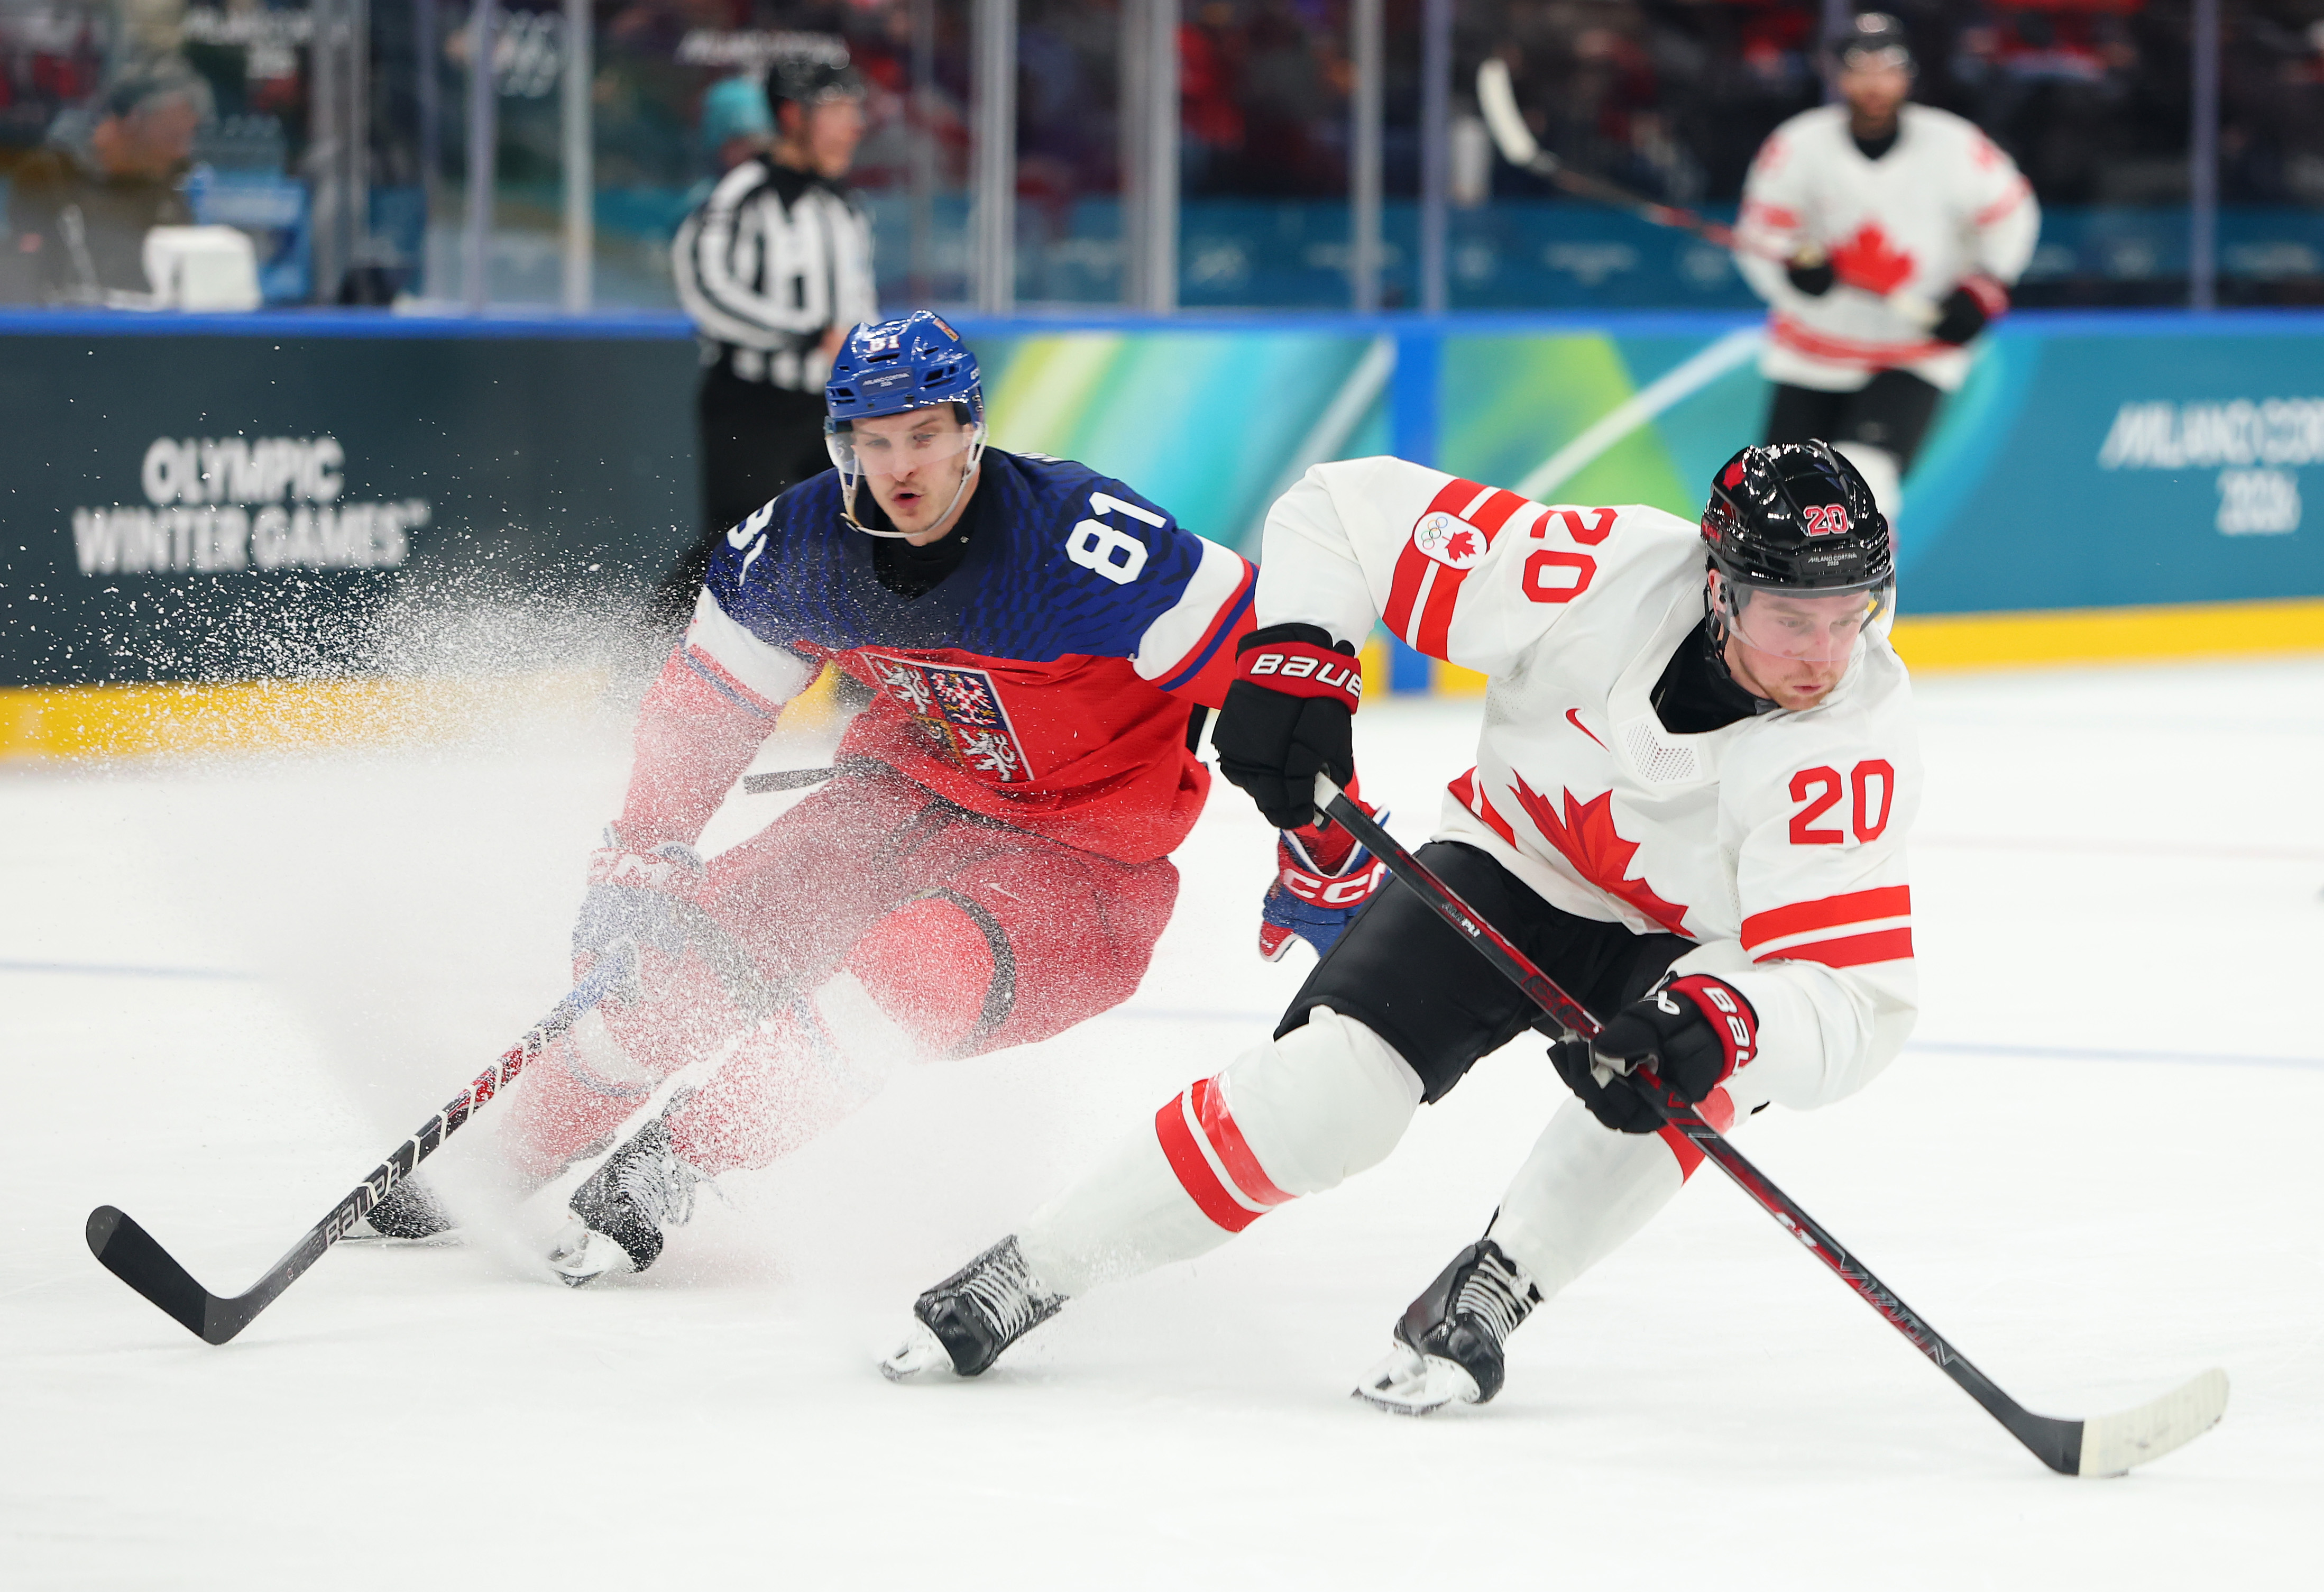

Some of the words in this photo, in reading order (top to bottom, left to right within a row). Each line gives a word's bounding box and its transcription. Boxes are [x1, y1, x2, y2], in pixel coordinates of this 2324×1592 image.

[2098, 399, 2262, 470] MILANO
[142, 436, 345, 506] OLYMPIC
[72, 506, 251, 575] WINTER
[1065, 491, 1166, 585] 81
[1803, 503, 1850, 537] 20
[1521, 508, 1618, 603] 20
[1808, 554, 1833, 563] MILANO
[1788, 759, 1894, 845] 20
